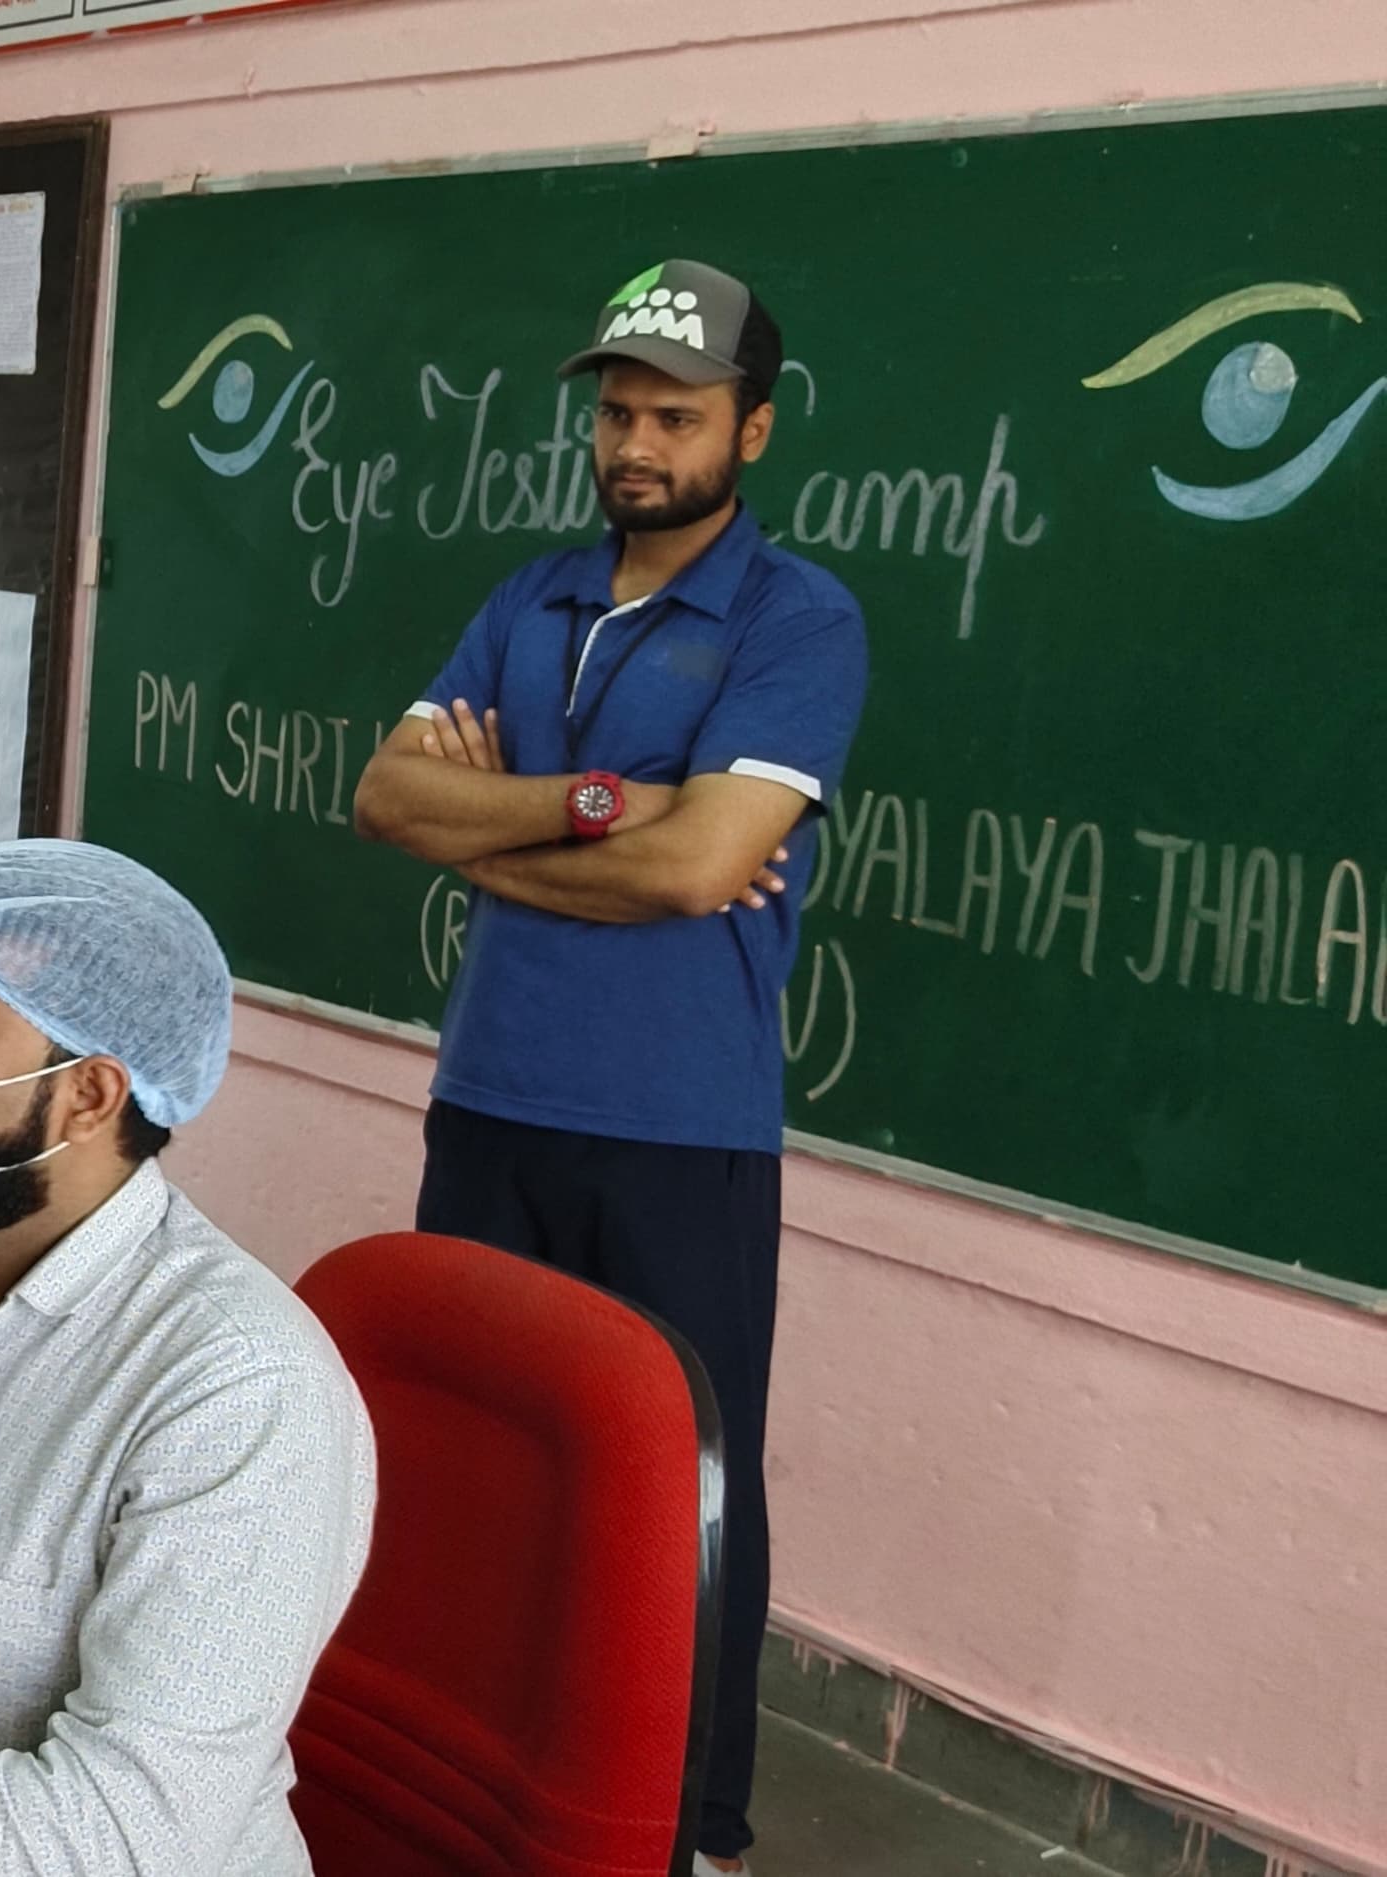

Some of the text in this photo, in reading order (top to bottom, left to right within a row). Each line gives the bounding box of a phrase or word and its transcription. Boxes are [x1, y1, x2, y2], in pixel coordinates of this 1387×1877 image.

[292, 377, 396, 607] Eye
[417, 364, 600, 540] Testi
[134, 670, 197, 783] PM
[215, 700, 350, 826] SHRI
